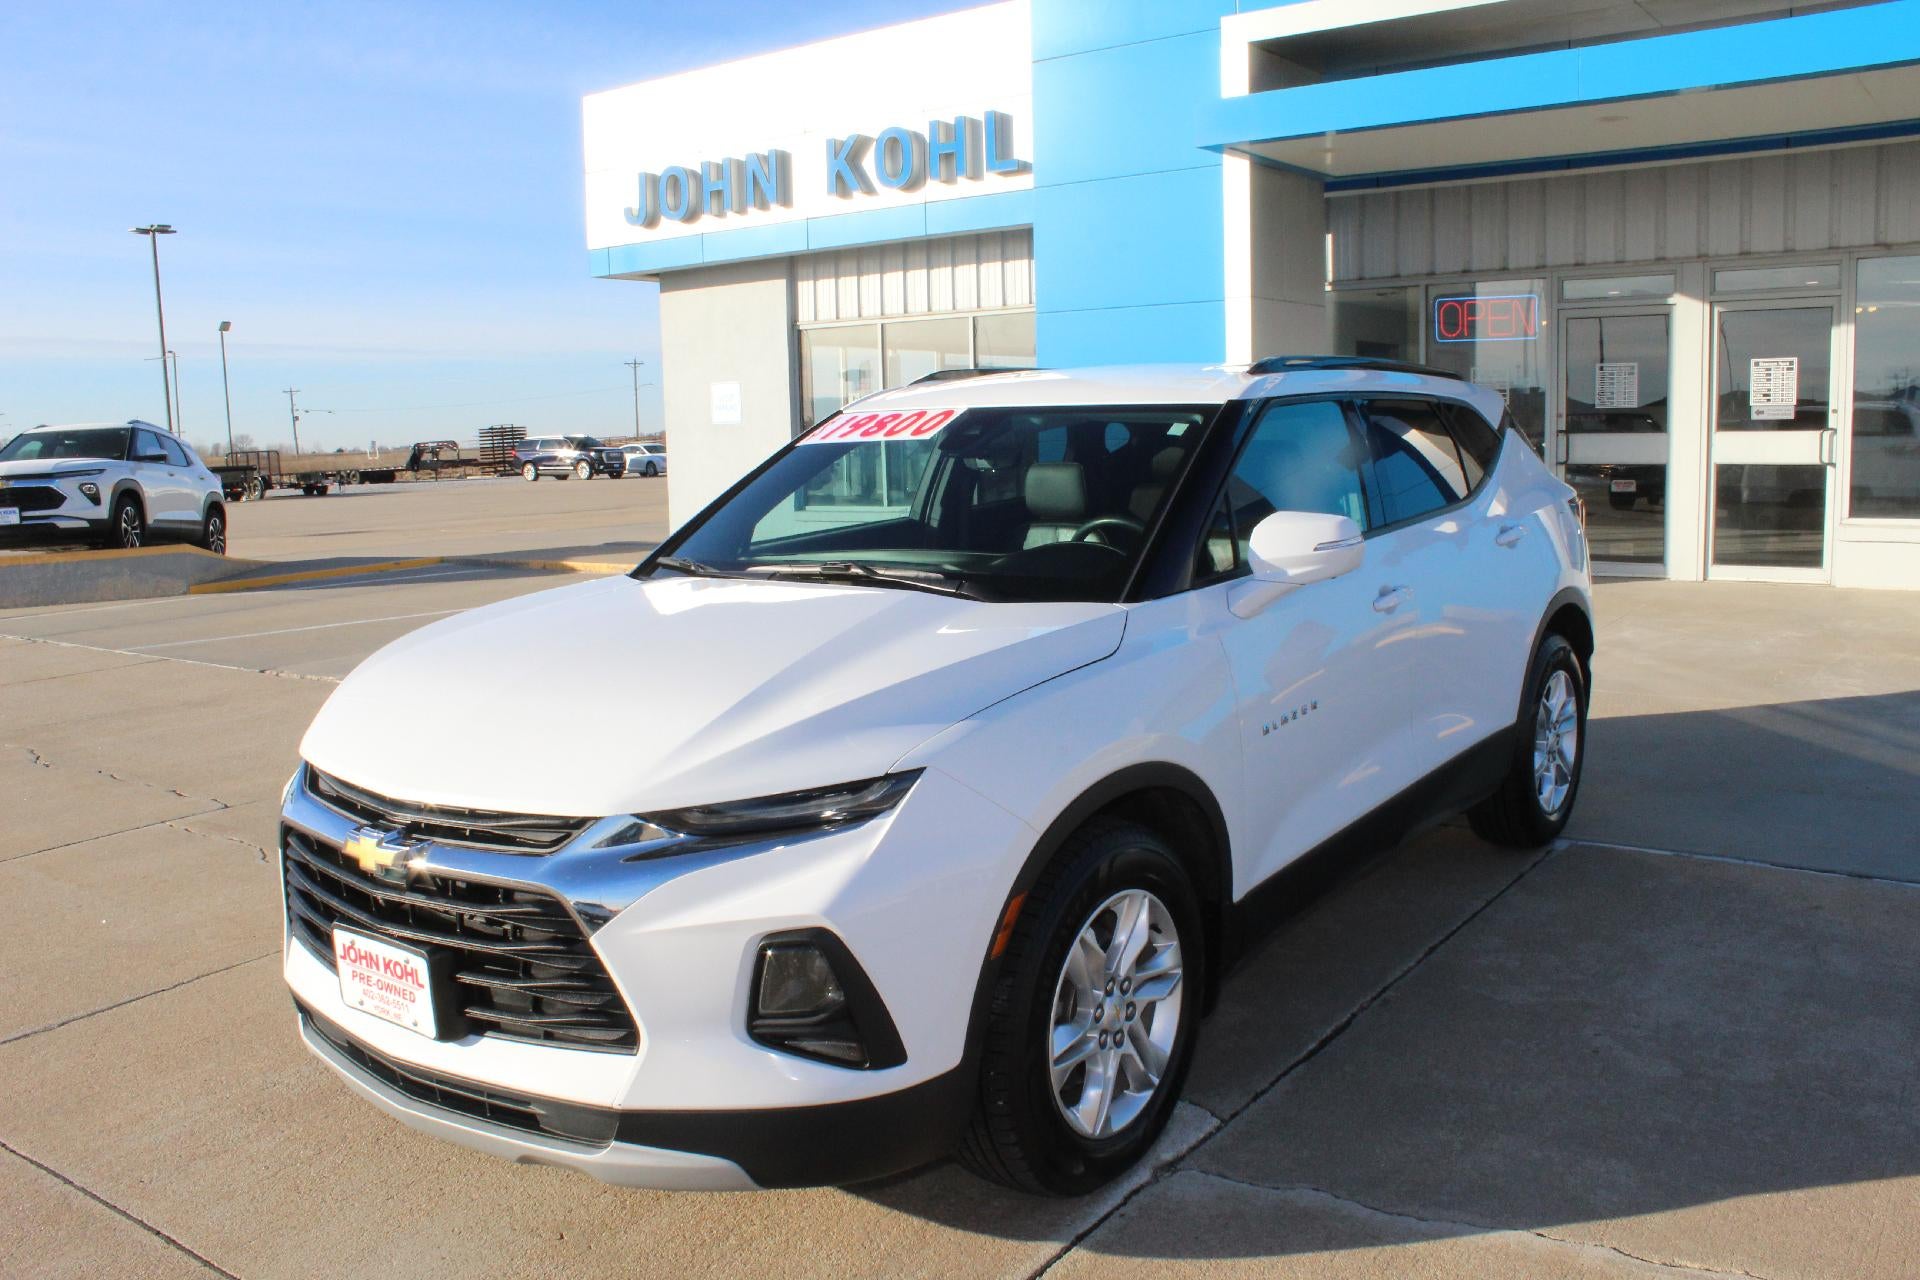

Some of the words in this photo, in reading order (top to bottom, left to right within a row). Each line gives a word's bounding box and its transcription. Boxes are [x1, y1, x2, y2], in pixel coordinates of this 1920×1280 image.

[624, 149, 793, 230] JOHN
[826, 110, 1033, 199] KOHL
[1440, 299, 1536, 338] OPEN
[340, 943, 380, 972] JOHN
[383, 956, 425, 989] KOHL
[352, 970, 416, 1004] PRE-OWNED
